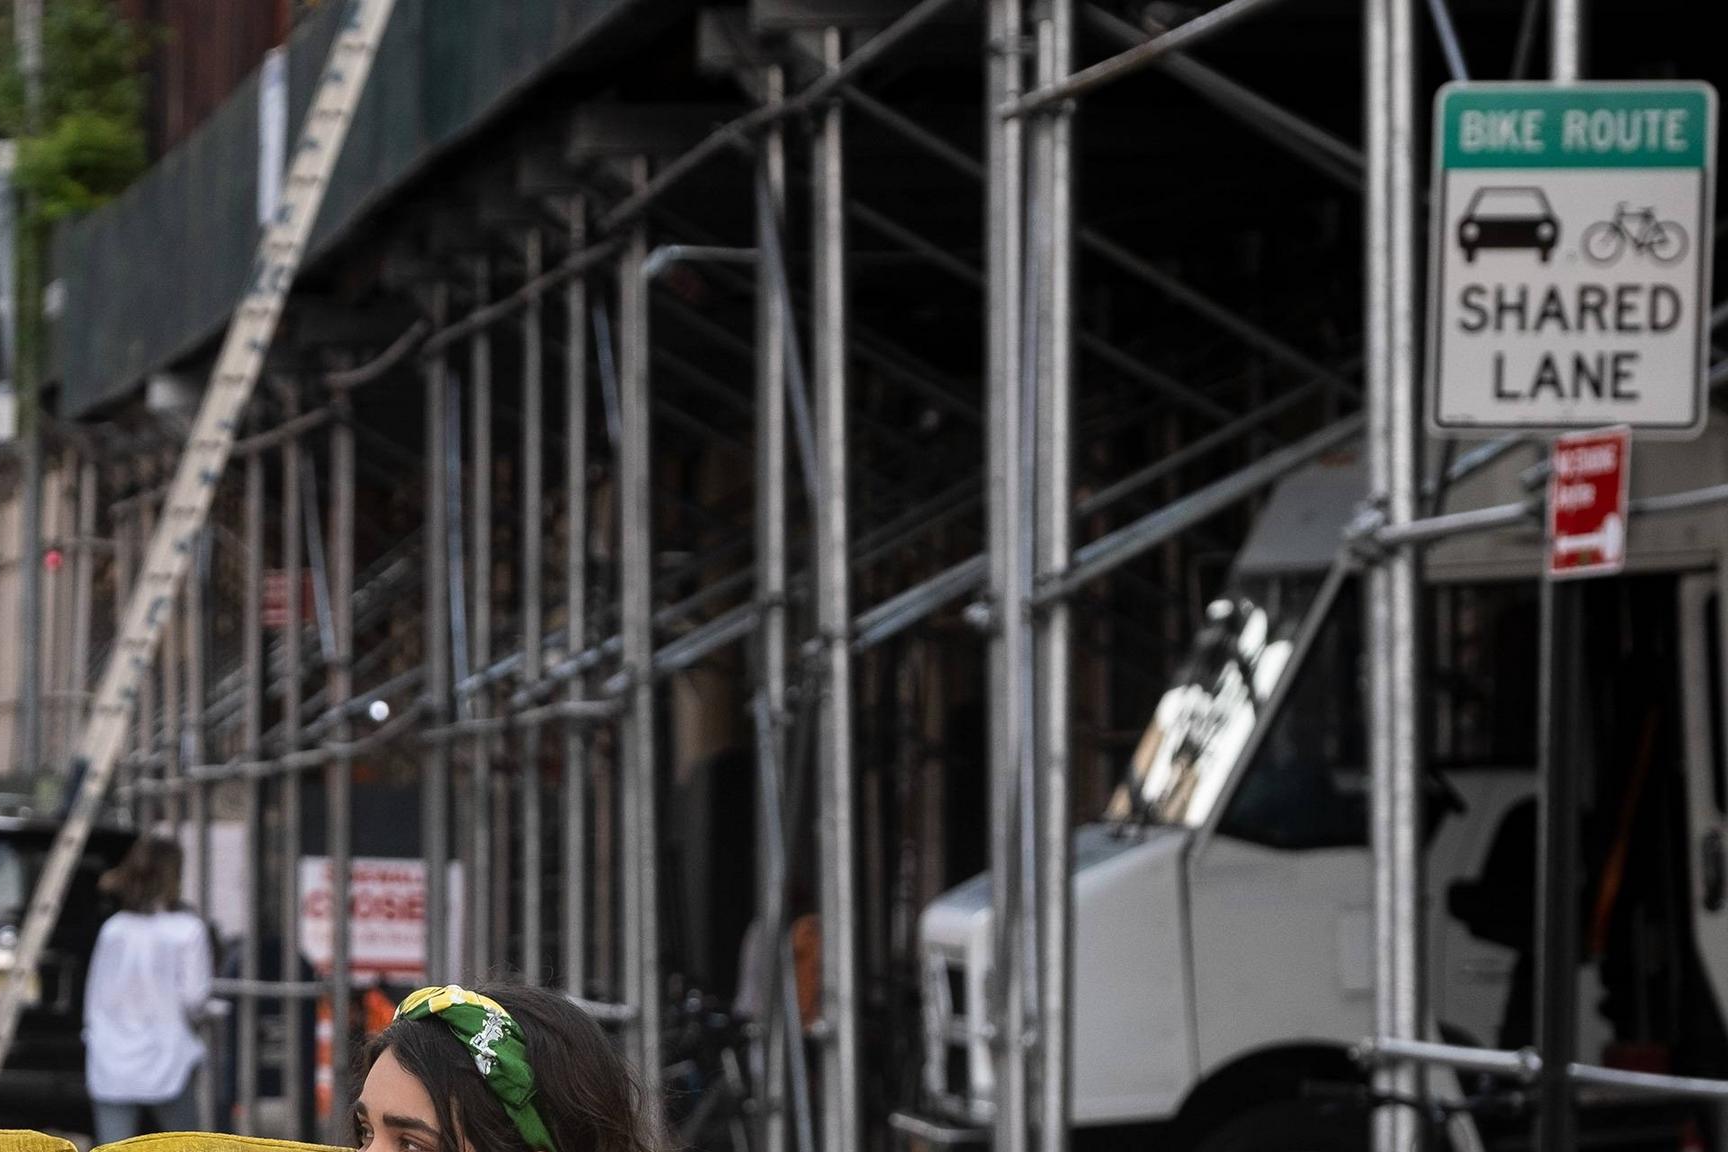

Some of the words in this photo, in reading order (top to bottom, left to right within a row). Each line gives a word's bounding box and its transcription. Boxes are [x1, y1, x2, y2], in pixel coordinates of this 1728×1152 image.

[1460, 108, 1545, 153] BIKE
[1562, 108, 1688, 153] ROUTE
[1459, 283, 1683, 334] SHARED
[1492, 350, 1640, 401] LANE
